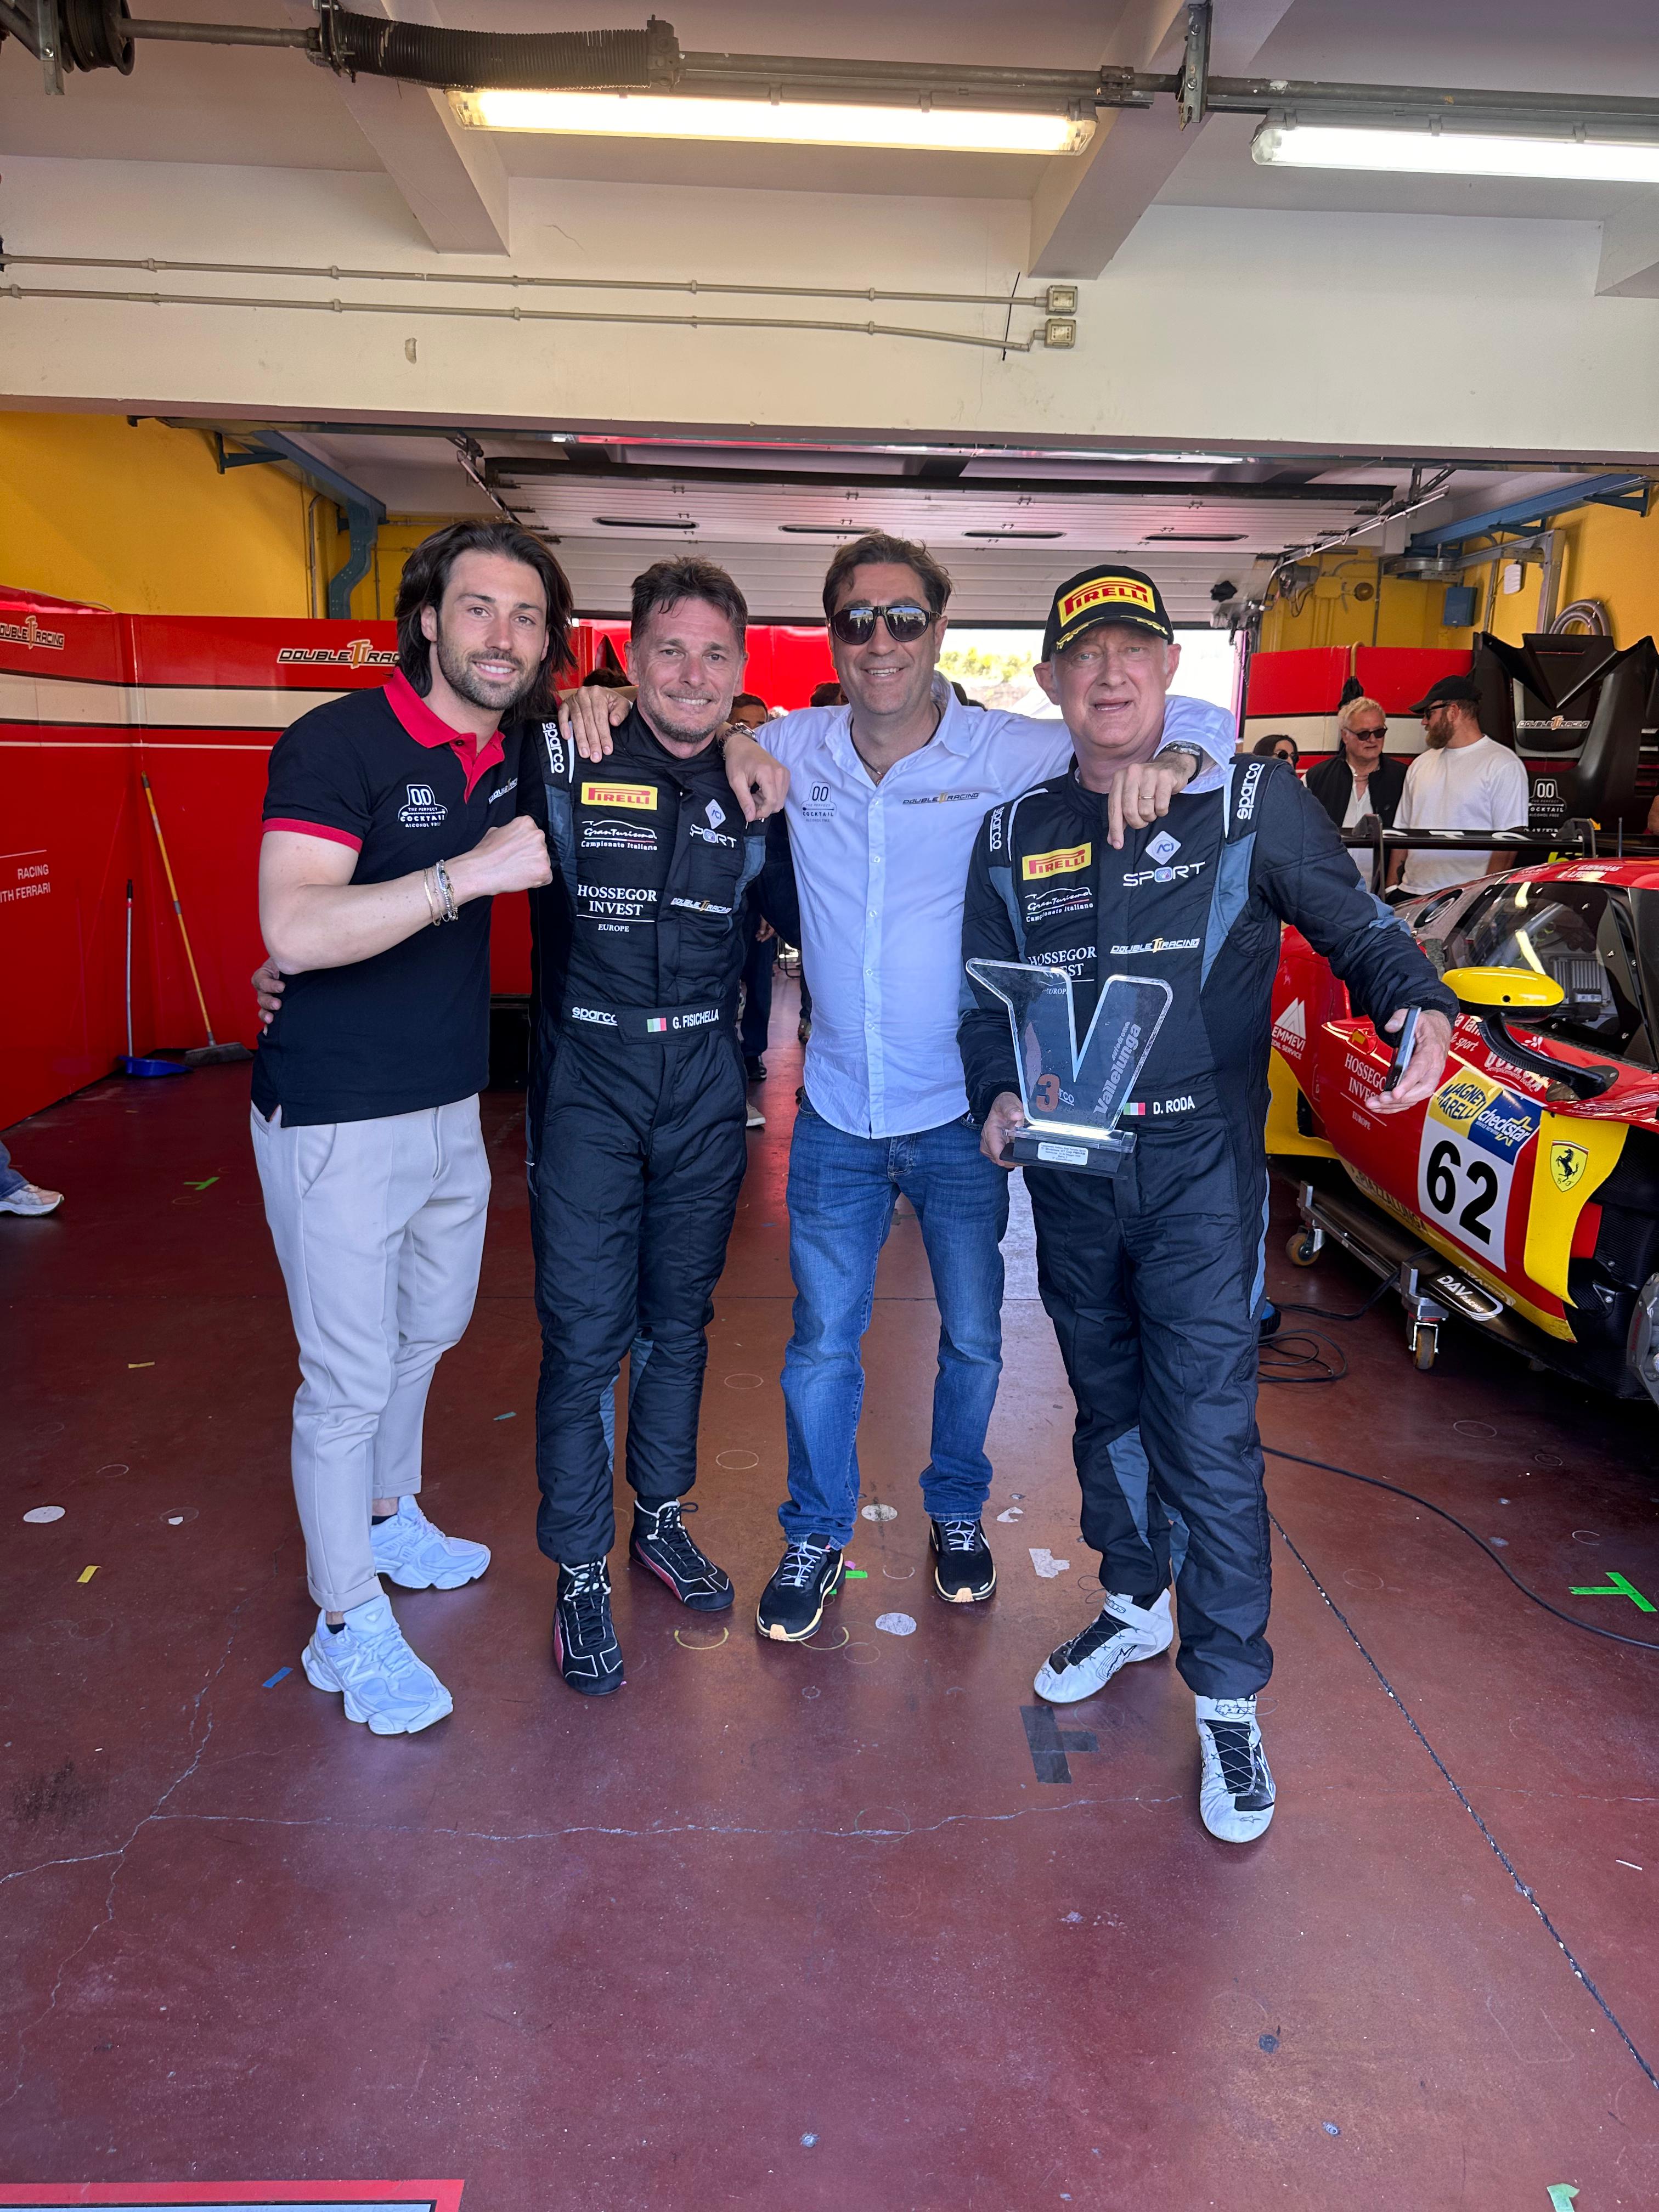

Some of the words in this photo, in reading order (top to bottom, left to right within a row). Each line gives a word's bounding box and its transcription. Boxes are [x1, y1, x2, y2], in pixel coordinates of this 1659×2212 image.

[1064, 581, 1149, 616] PIRELLI
[0, 624, 28, 639] OUBLE
[36, 630, 64, 645] RACING
[279, 650, 351, 661] DOUBLE
[542, 722, 565, 773] sparco
[588, 788, 651, 805] PIRELLI
[1237, 763, 1263, 820] sparco
[990, 806, 1005, 851] sparco
[627, 842, 657, 850] Italiano
[1156, 843, 1174, 853] ACI
[1029, 849, 1086, 874] PIRELLI
[18, 864, 49, 880] RACING
[1123, 861, 1205, 886] SPORT
[16, 882, 50, 900] FERRARI
[577, 884, 658, 901] HOSSEGOR
[589, 900, 644, 916] INVEST
[672, 898, 701, 907] DOUBLE
[707, 904, 732, 913] RACING
[1026, 908, 1063, 922] Campionato
[1064, 902, 1093, 912] Italiano
[598, 924, 629, 932] EUROPE
[1111, 943, 1152, 953] DOUBLE
[1161, 938, 1200, 948] RACING
[673, 1017, 681, 1029] G.
[683, 1009, 719, 1028] FISICHELLA
[1111, 1022, 1130, 1061] autodromo
[1271, 1026, 1306, 1052] EMMEVI
[1093, 1024, 1141, 1114] Vallelunga
[1036, 1074, 1060, 1112] 3
[1153, 1102, 1163, 1114] D.
[1166, 1095, 1195, 1113] RODA
[1352, 1111, 1371, 1130] EUROPE
[1478, 1109, 1531, 1142] checkstar
[1427, 1141, 1498, 1246] 62
[1437, 1275, 1474, 1296] DAV
[1459, 1295, 1485, 1312] RACING
